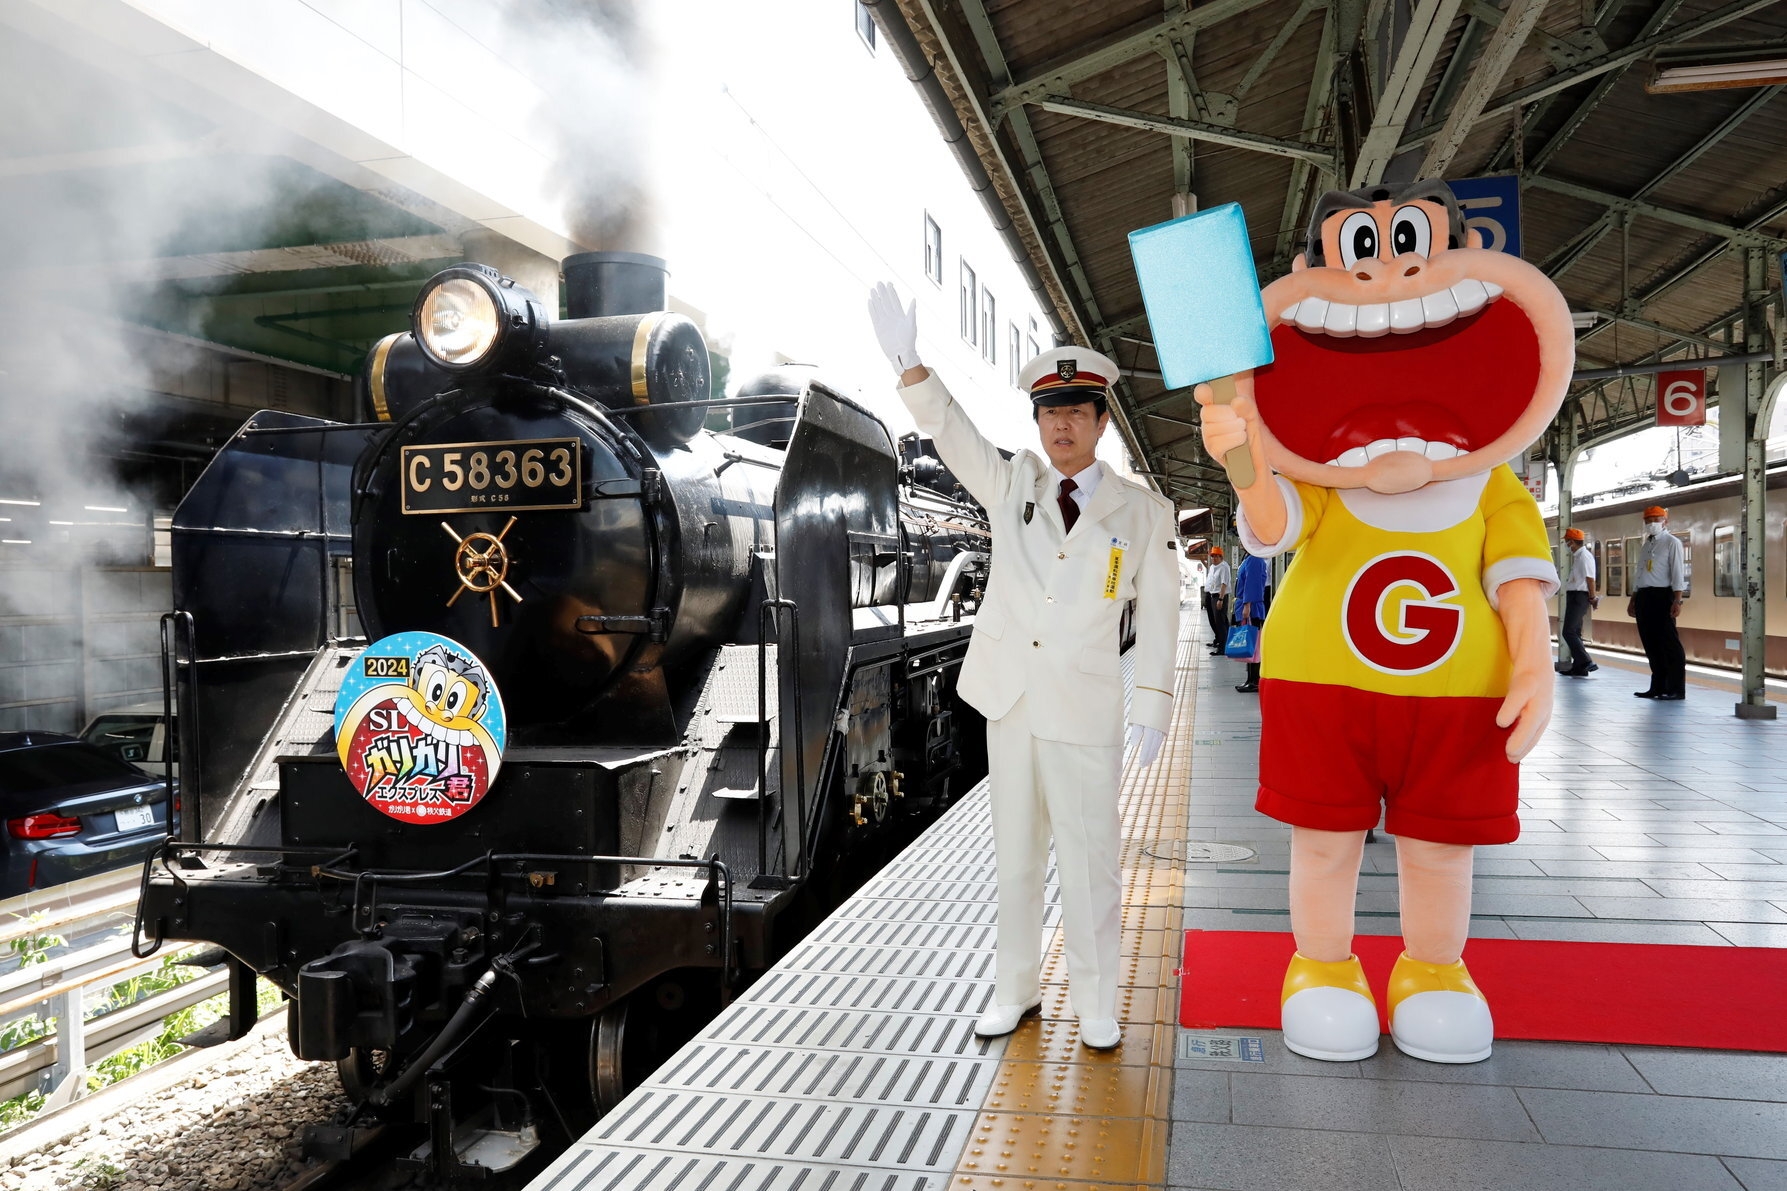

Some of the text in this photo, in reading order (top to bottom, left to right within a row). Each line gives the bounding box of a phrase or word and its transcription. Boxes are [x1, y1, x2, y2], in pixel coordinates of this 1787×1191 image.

[1663, 380, 1698, 416] 6
[1341, 550, 1465, 676] G
[367, 659, 408, 676] 2024
[369, 709, 409, 732] SL
[377, 785, 440, 802] エクスプレス
